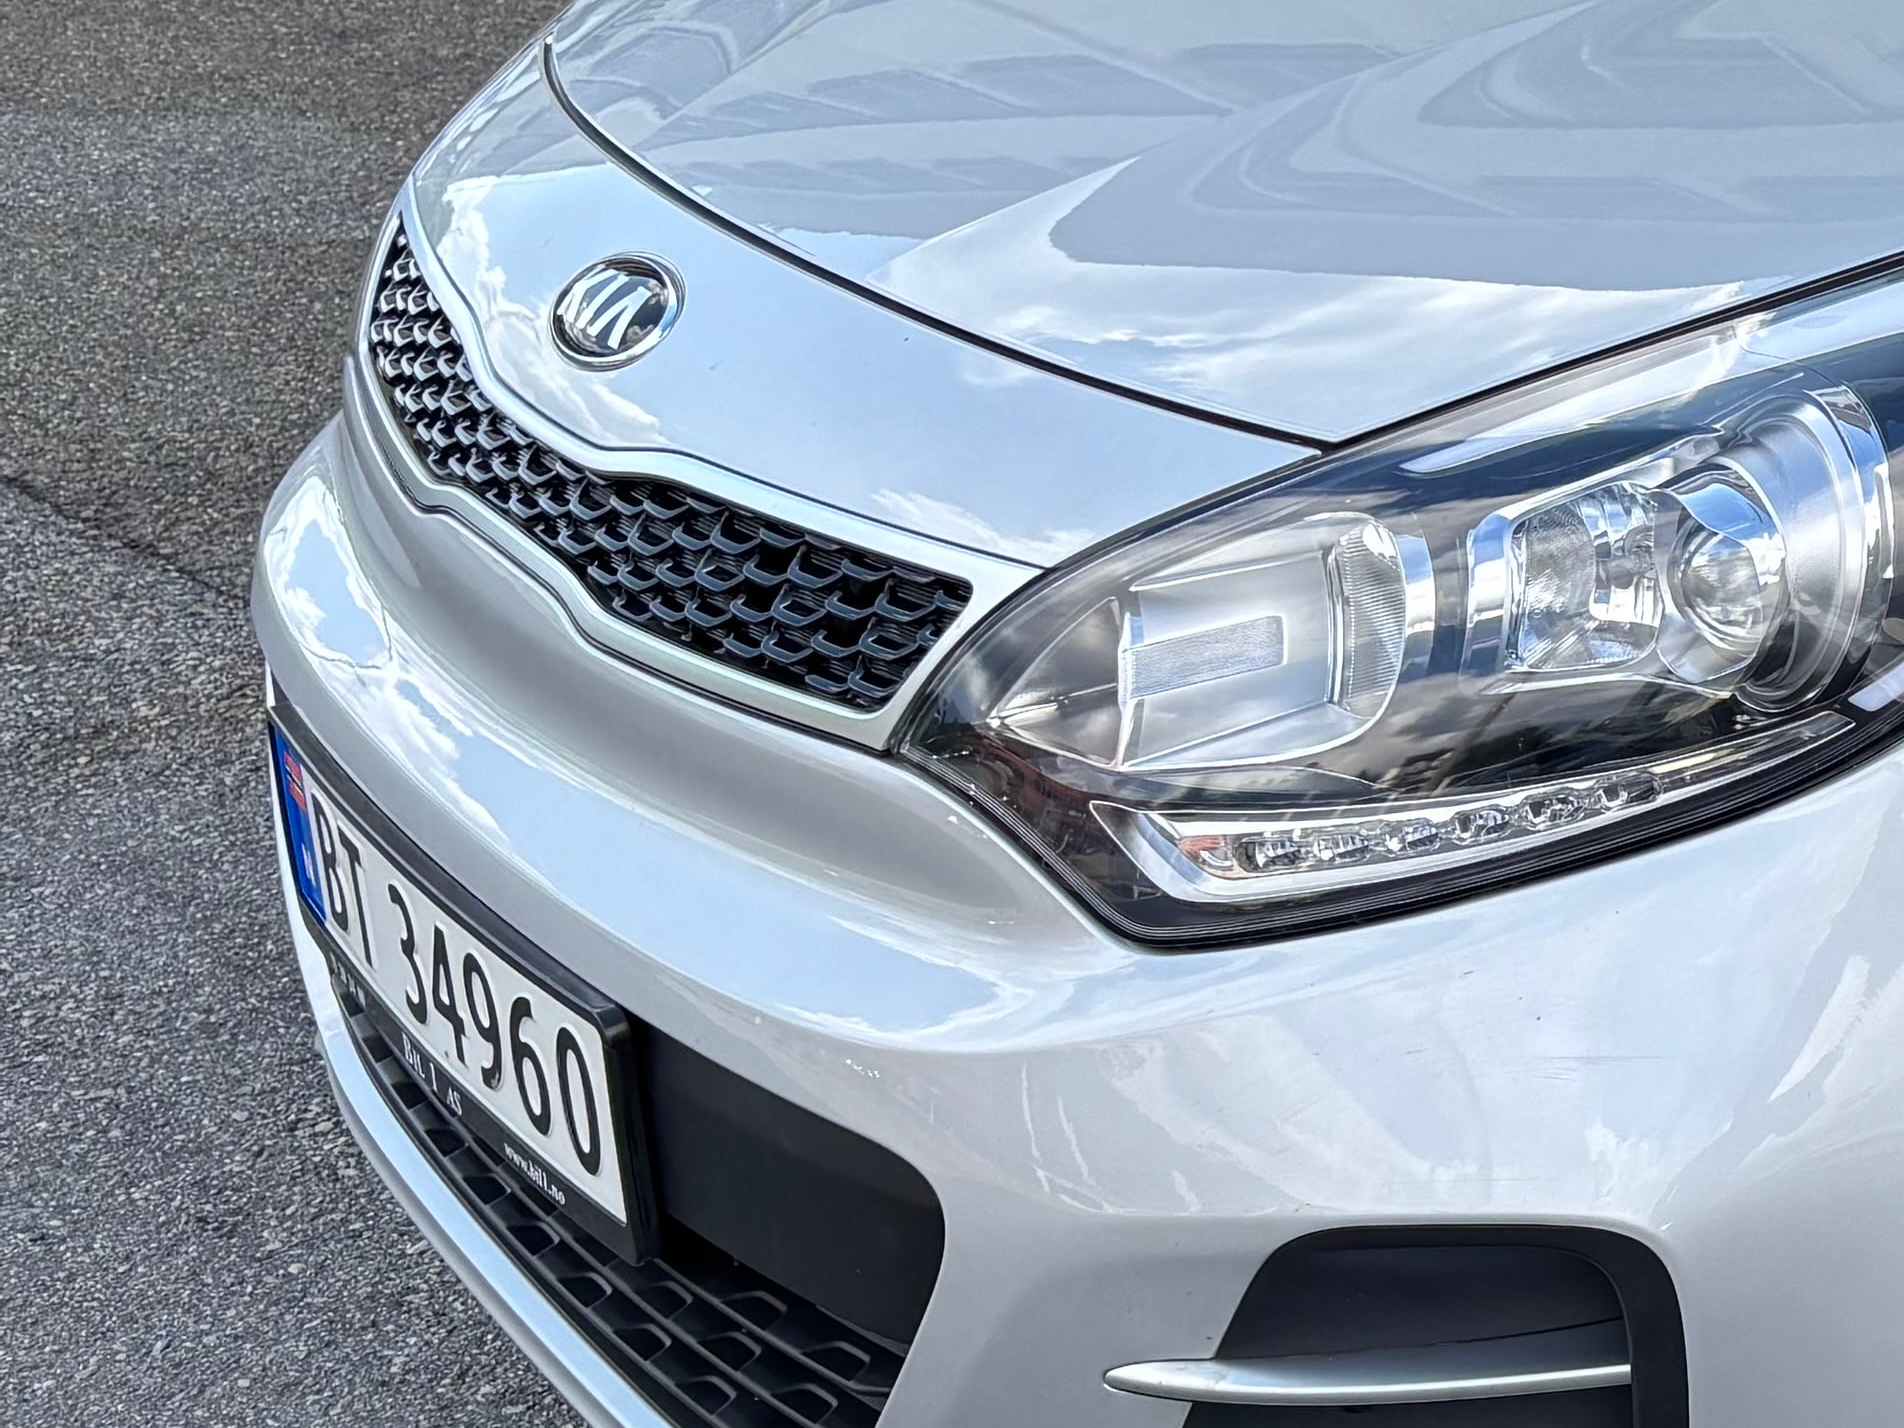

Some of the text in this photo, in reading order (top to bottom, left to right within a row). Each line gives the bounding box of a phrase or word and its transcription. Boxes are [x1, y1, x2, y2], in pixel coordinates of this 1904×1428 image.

[556, 264, 653, 351] KIA
[310, 789, 603, 1178] BT 34960
[446, 1087, 463, 1116] AS
